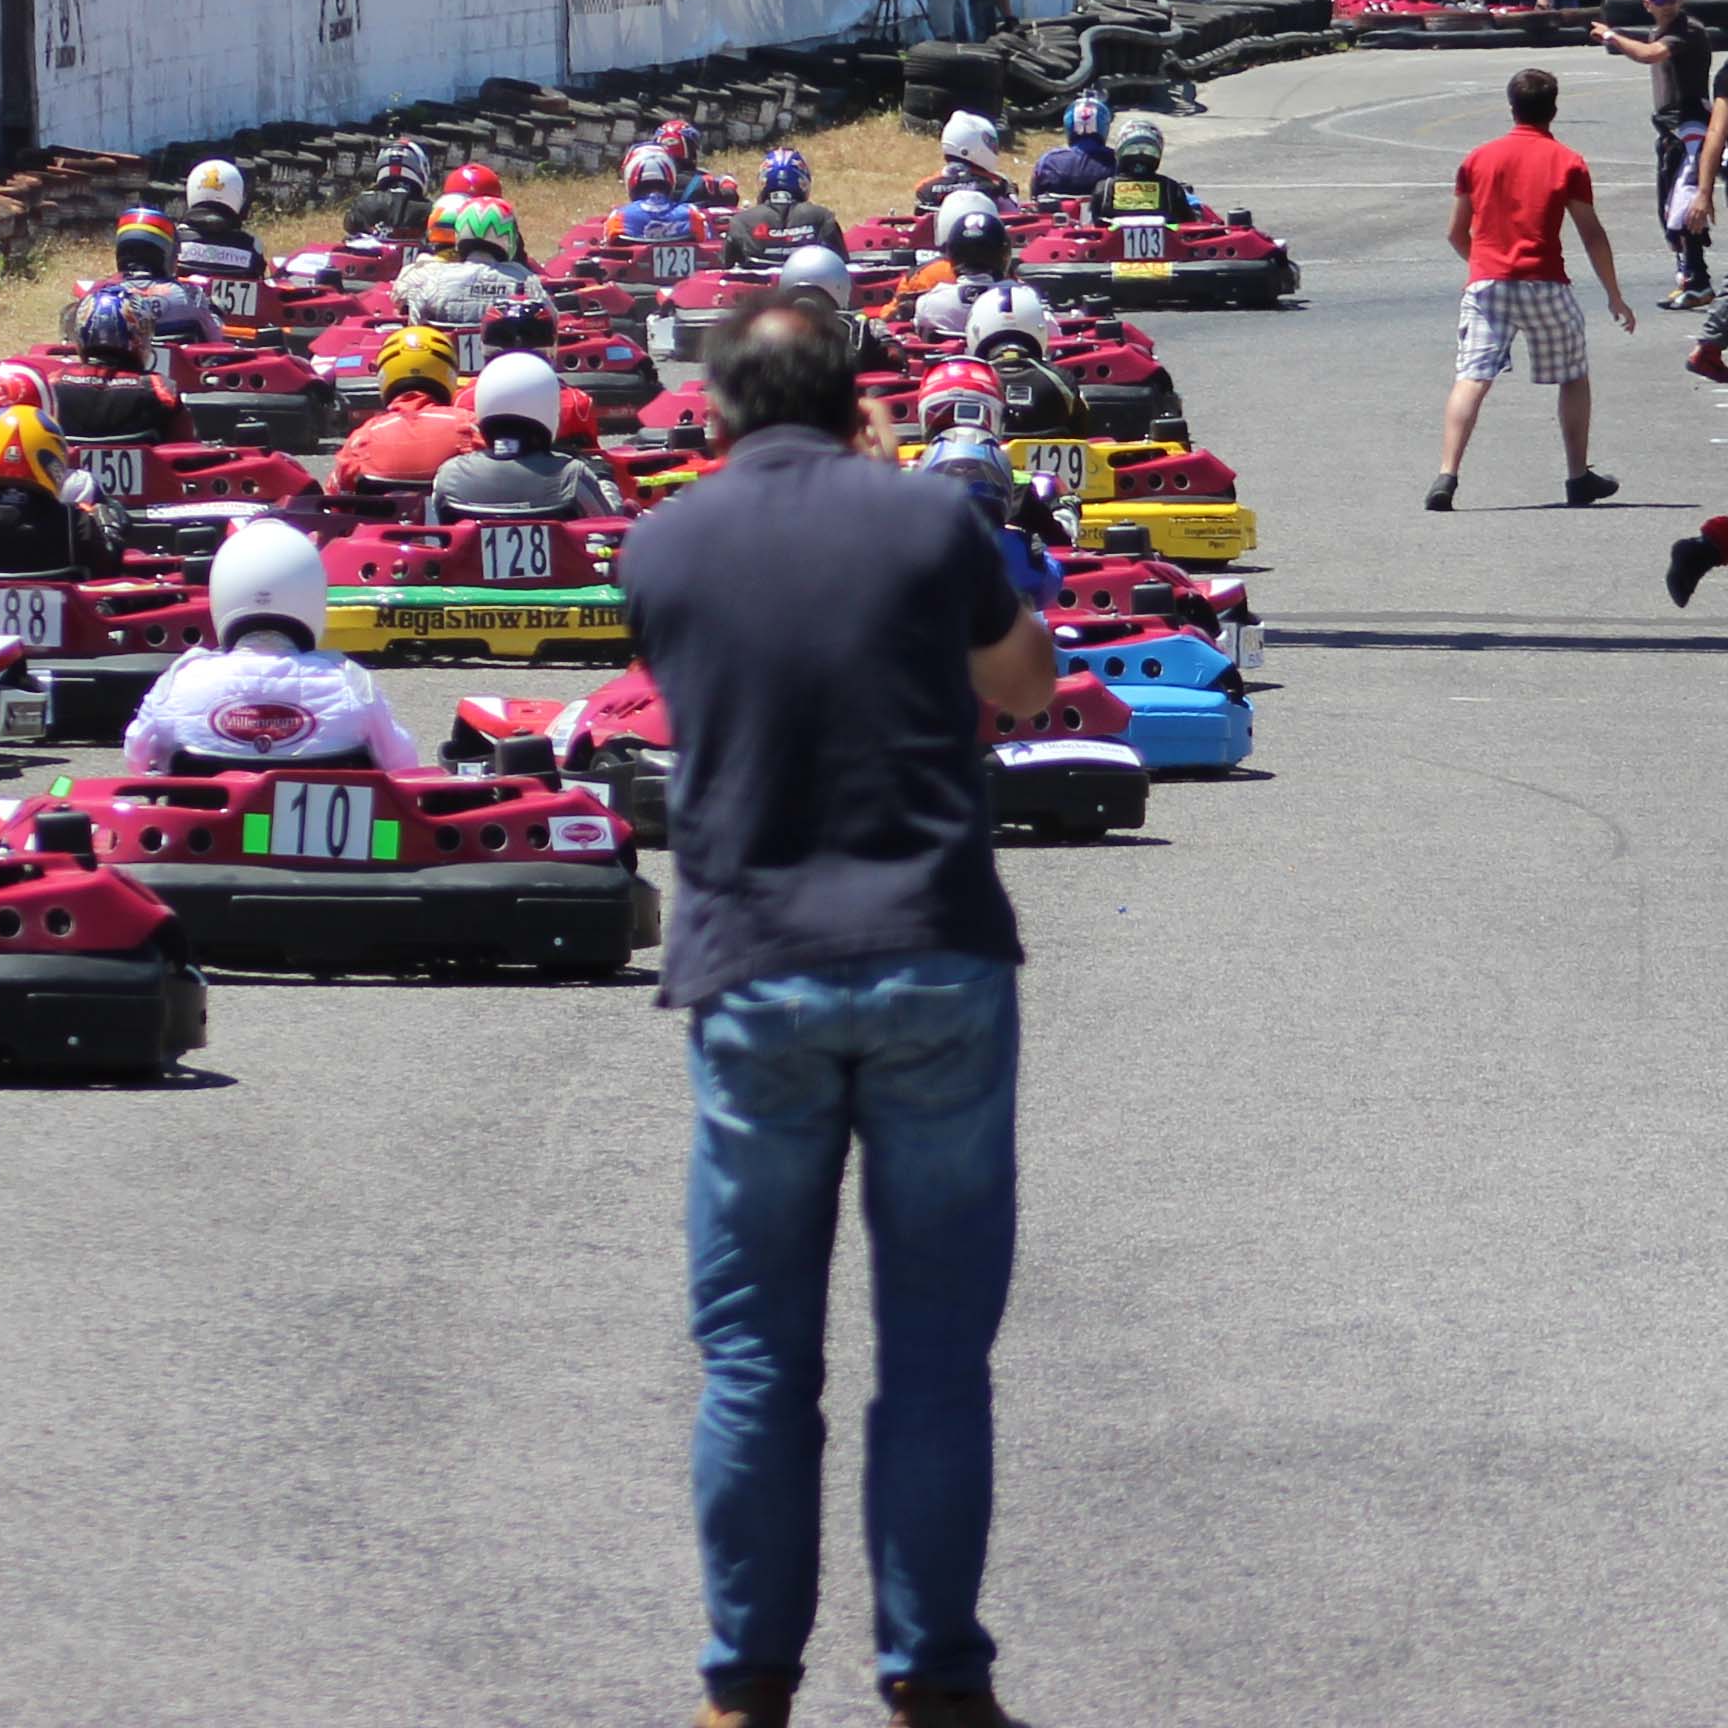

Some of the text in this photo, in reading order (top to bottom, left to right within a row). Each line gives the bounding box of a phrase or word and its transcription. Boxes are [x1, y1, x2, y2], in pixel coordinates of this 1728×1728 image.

[655, 248, 691, 278] 123
[1127, 228, 1161, 258] 103
[212, 280, 250, 314] 157
[83, 451, 132, 495] 150
[1030, 445, 1083, 489] 129
[485, 525, 547, 579] 128
[3, 588, 46, 645] 88
[291, 783, 351, 858] 10
